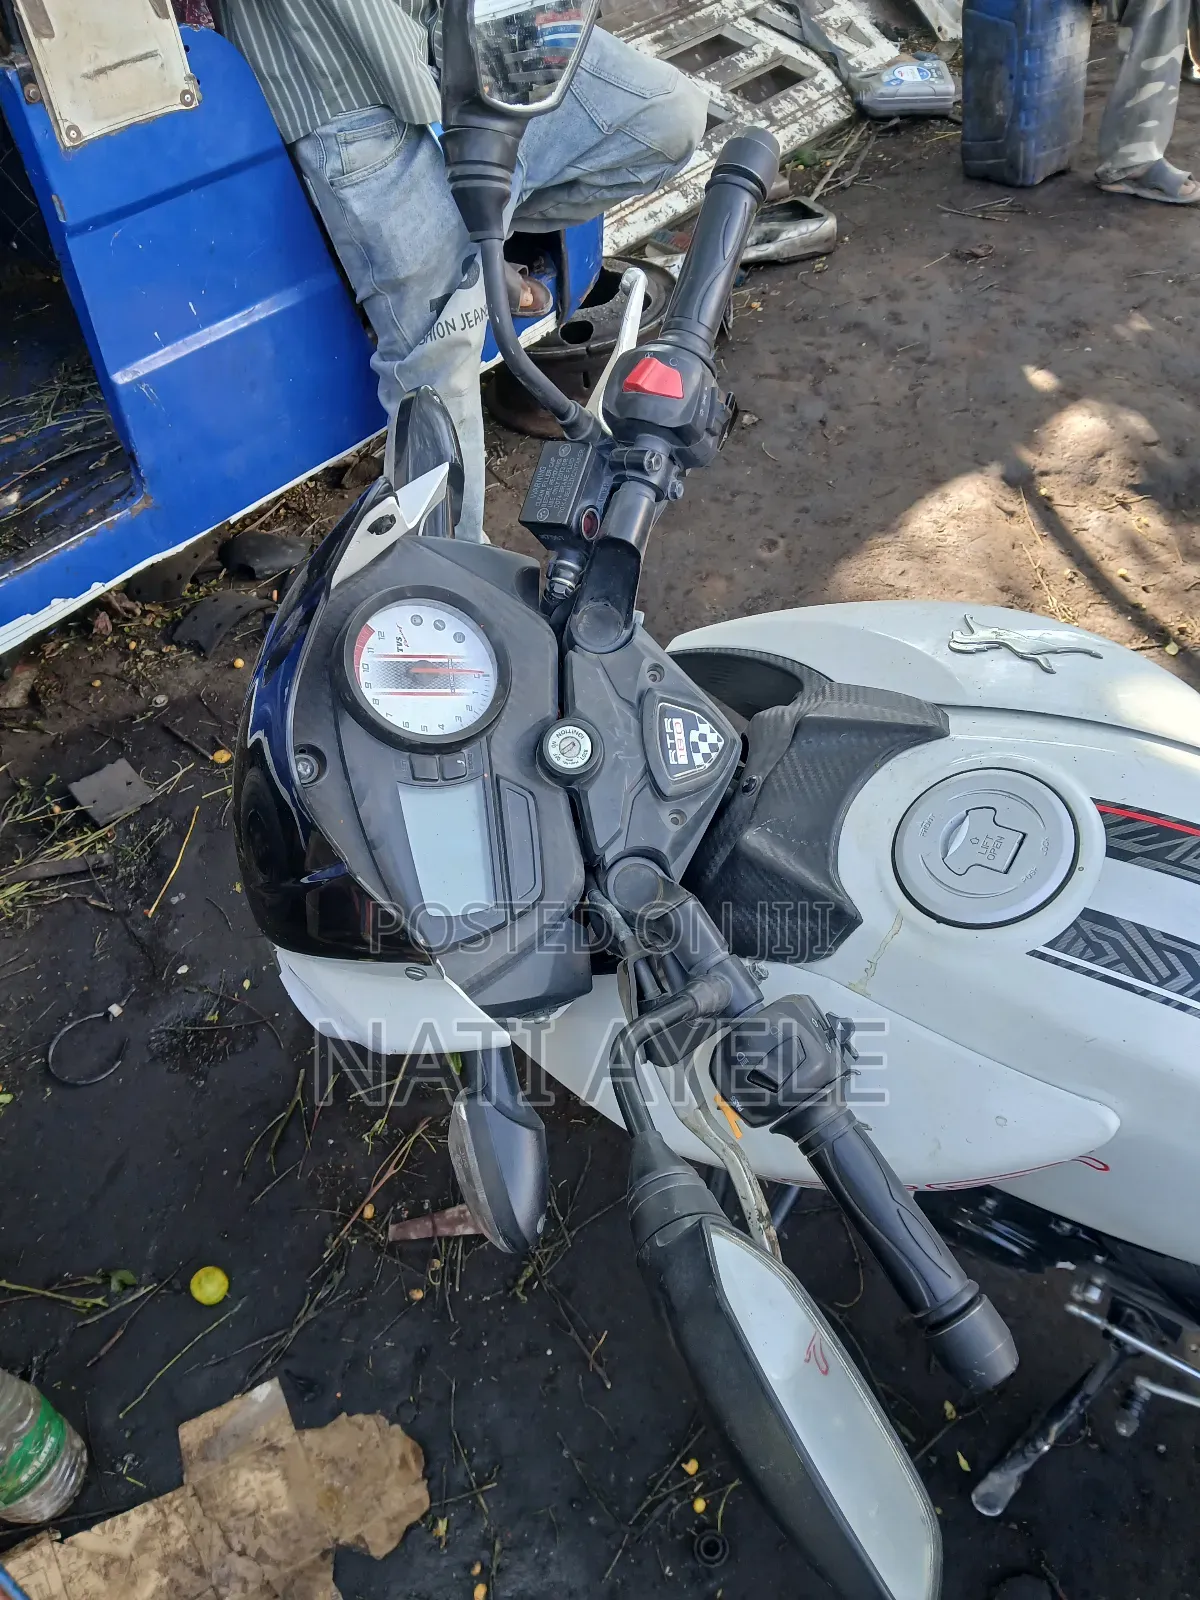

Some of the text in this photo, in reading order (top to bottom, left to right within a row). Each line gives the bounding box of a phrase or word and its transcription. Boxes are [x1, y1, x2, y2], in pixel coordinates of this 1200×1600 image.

[418, 317, 457, 345] HION
[460, 303, 488, 331] JEAN
[530, 466, 546, 499] WARNING
[378, 630, 386, 640] 12
[396, 636, 404, 652] TVS
[556, 728, 584, 740] IGNITION
[978, 834, 994, 856] LIFT
[986, 835, 1005, 860] OPEN
